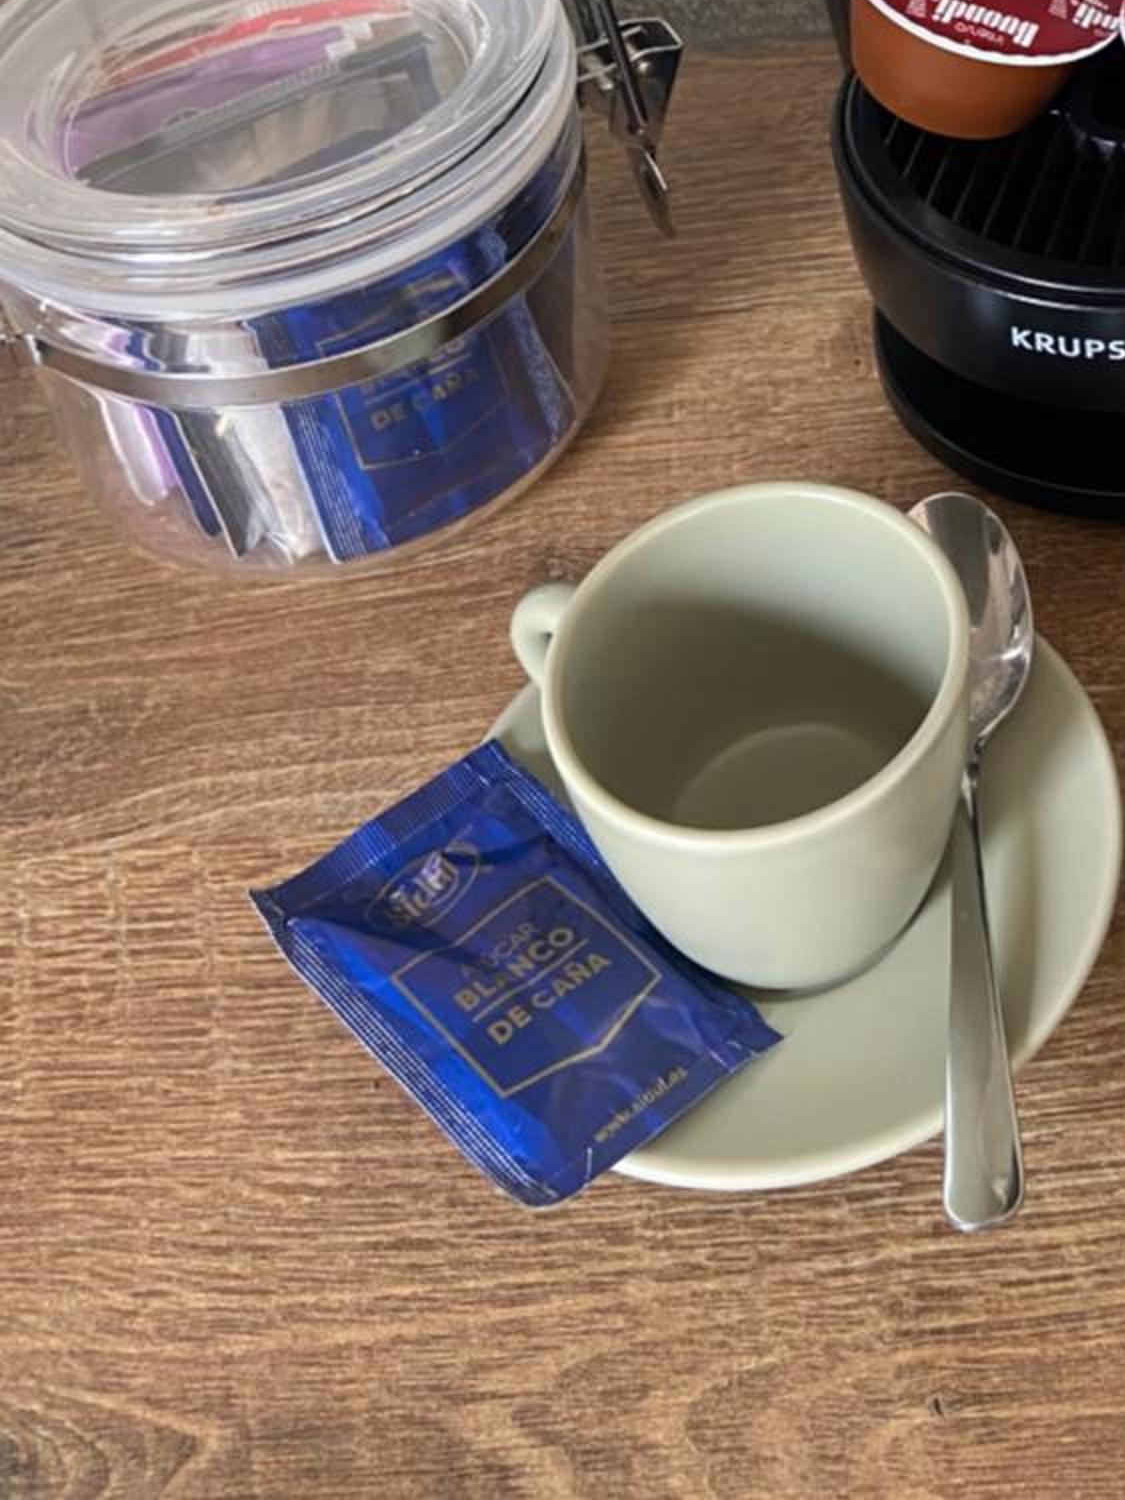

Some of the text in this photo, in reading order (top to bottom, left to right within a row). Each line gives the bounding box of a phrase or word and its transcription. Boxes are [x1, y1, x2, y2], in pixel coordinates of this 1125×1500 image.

[459, 922, 541, 980] AUCAR
[487, 953, 612, 1045] DE CAÑA
